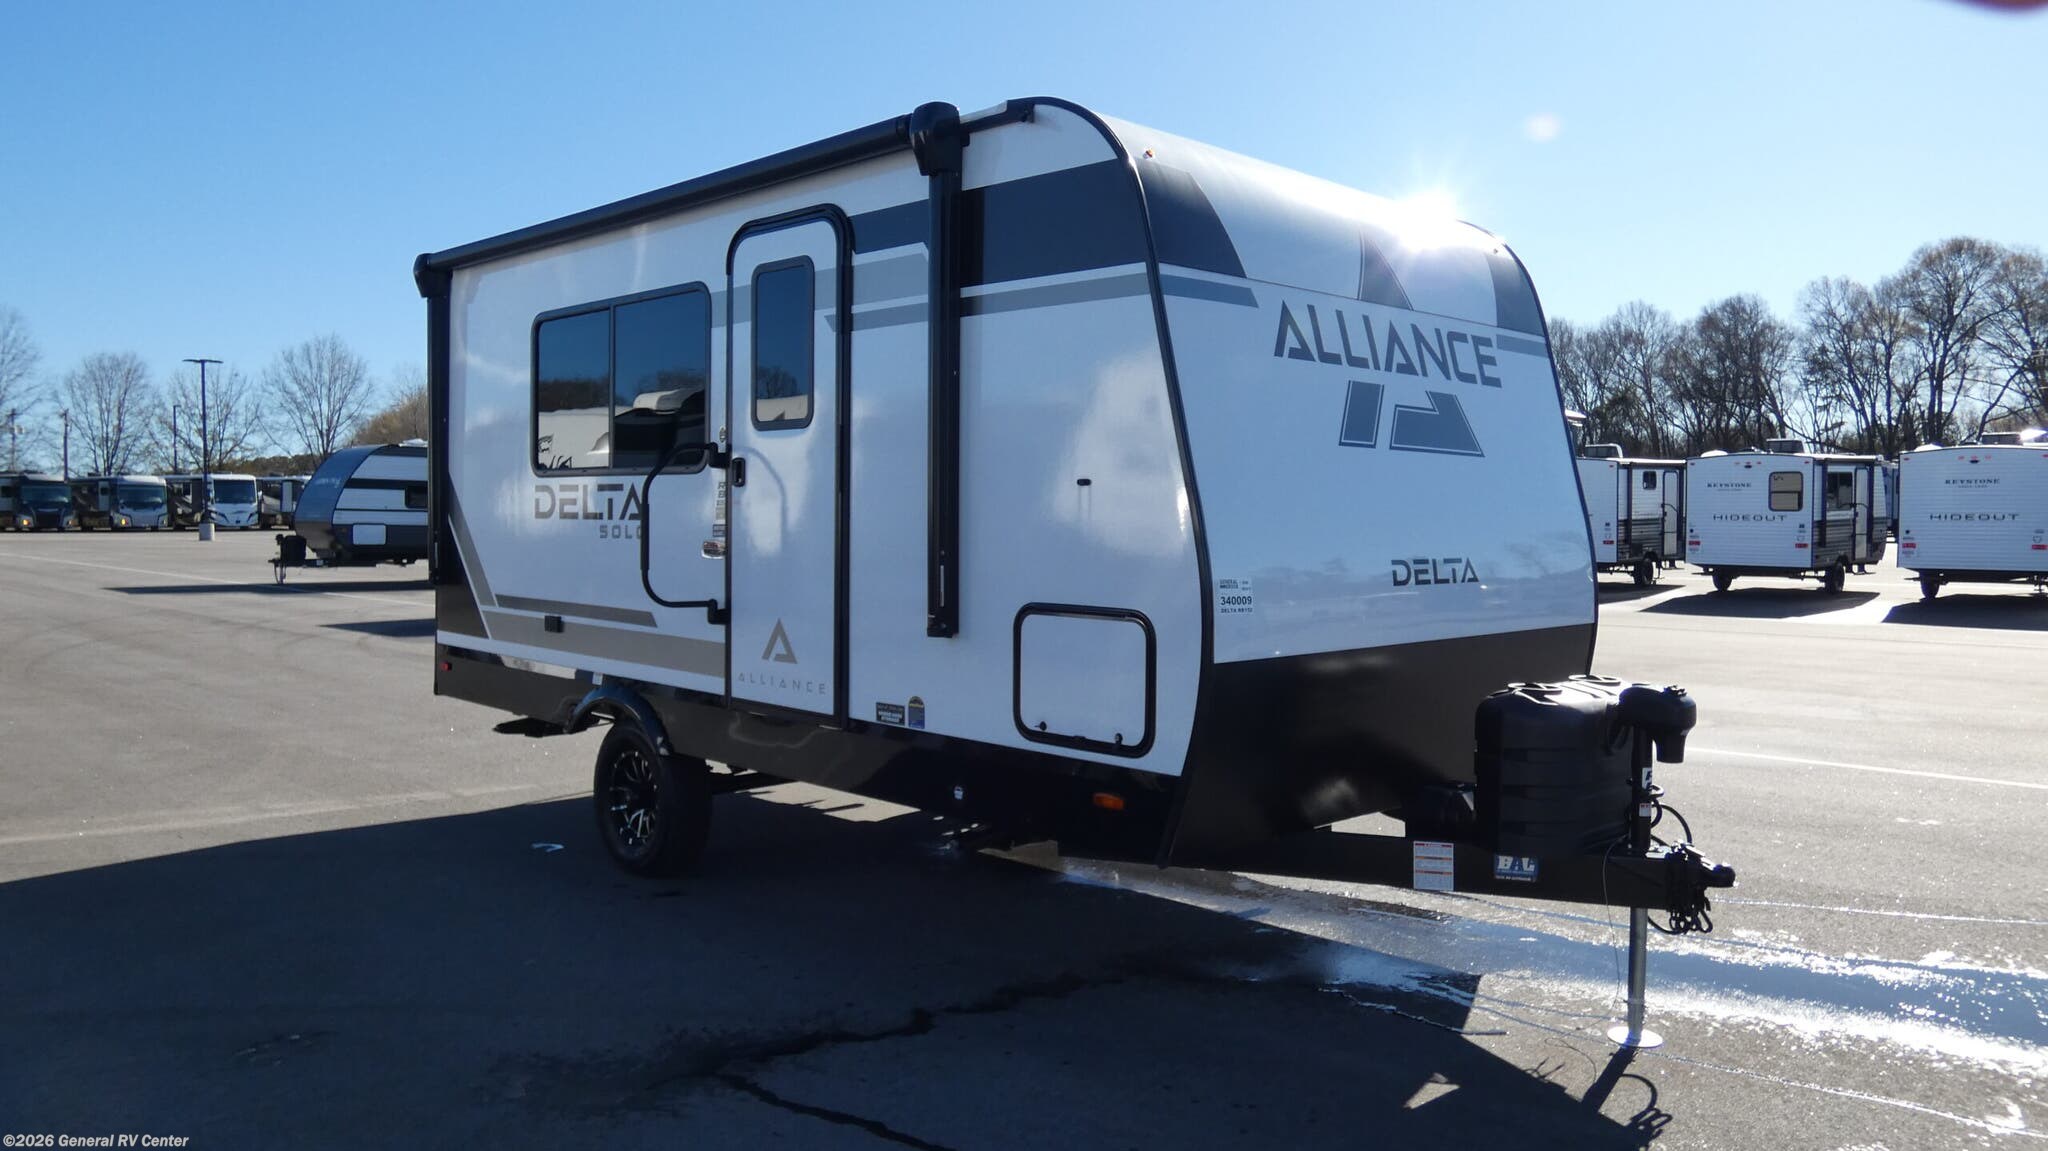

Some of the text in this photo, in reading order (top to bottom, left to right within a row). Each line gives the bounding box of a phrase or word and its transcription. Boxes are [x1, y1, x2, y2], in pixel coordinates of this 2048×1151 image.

[1274, 301, 1502, 388] ALLIANCE
[534, 483, 643, 520] DELTA
[1713, 514, 1788, 522] HIDEOUT
[1391, 558, 1479, 587] DELTA
[1220, 596, 1252, 606] 340009
[738, 672, 827, 695] ALLIANCE
[1497, 856, 1536, 872] BAL
